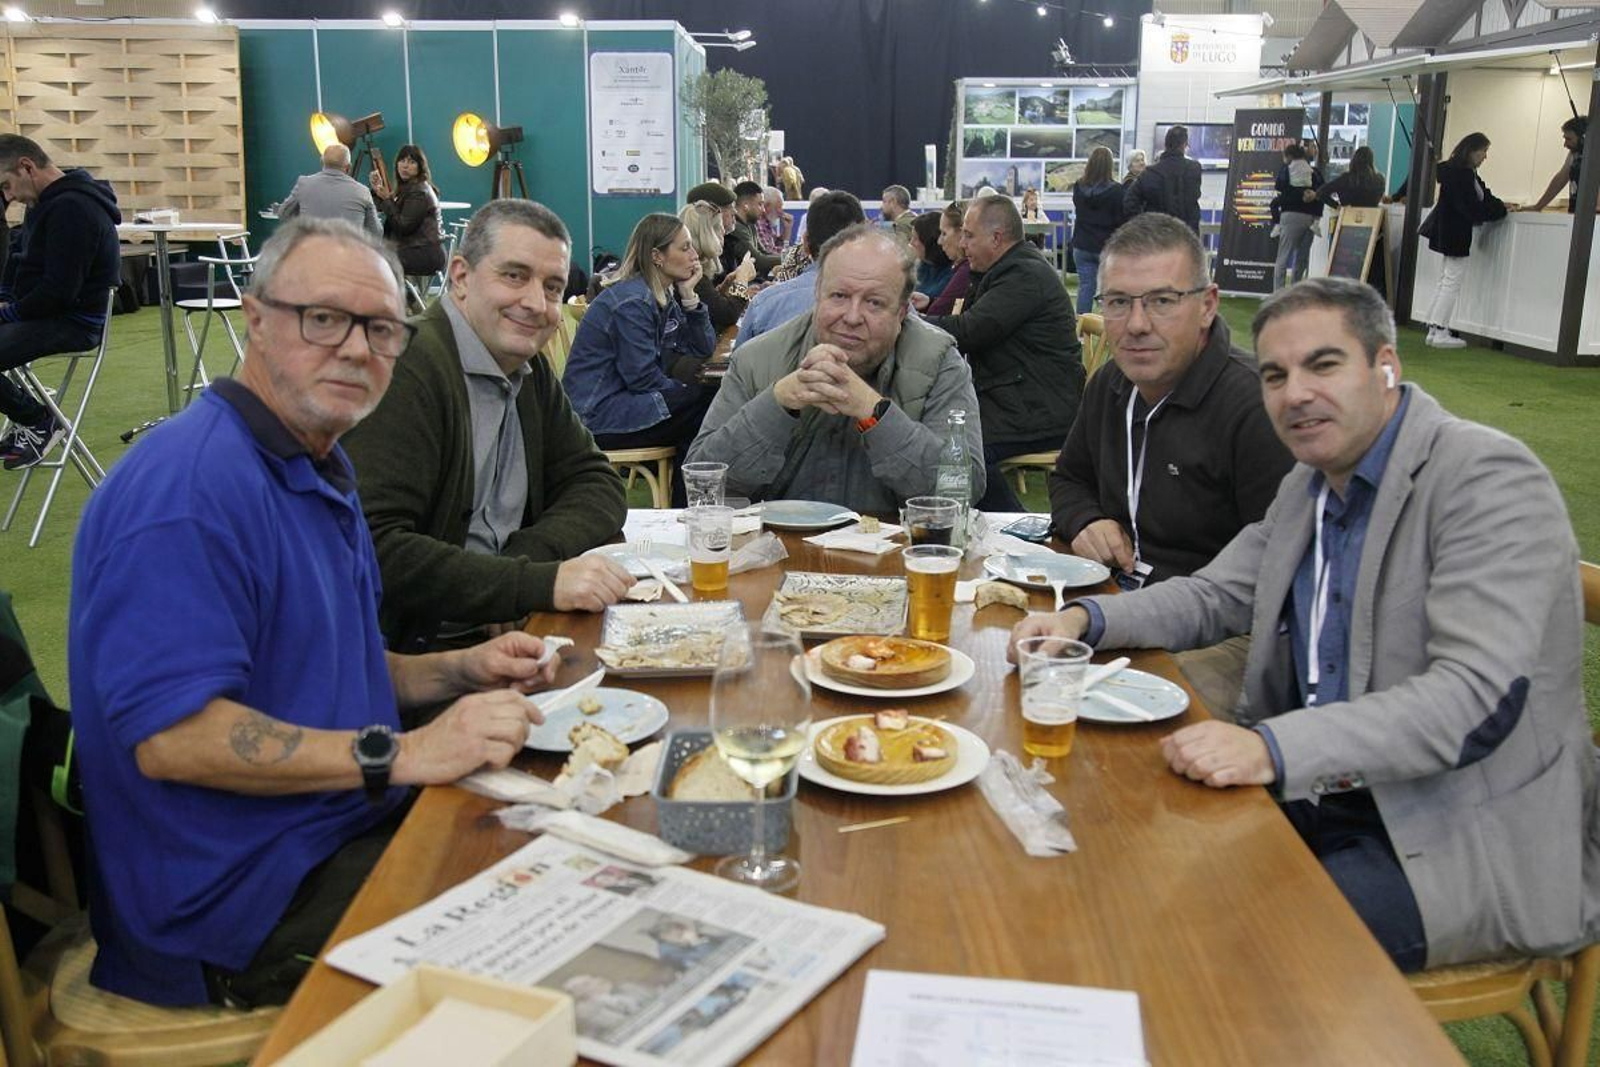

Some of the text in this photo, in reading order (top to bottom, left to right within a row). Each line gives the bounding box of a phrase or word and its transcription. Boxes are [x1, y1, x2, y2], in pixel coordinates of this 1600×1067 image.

[1202, 51, 1237, 64] LUGO
[1251, 122, 1285, 137] COMIDA
[394, 922, 448, 948] La
